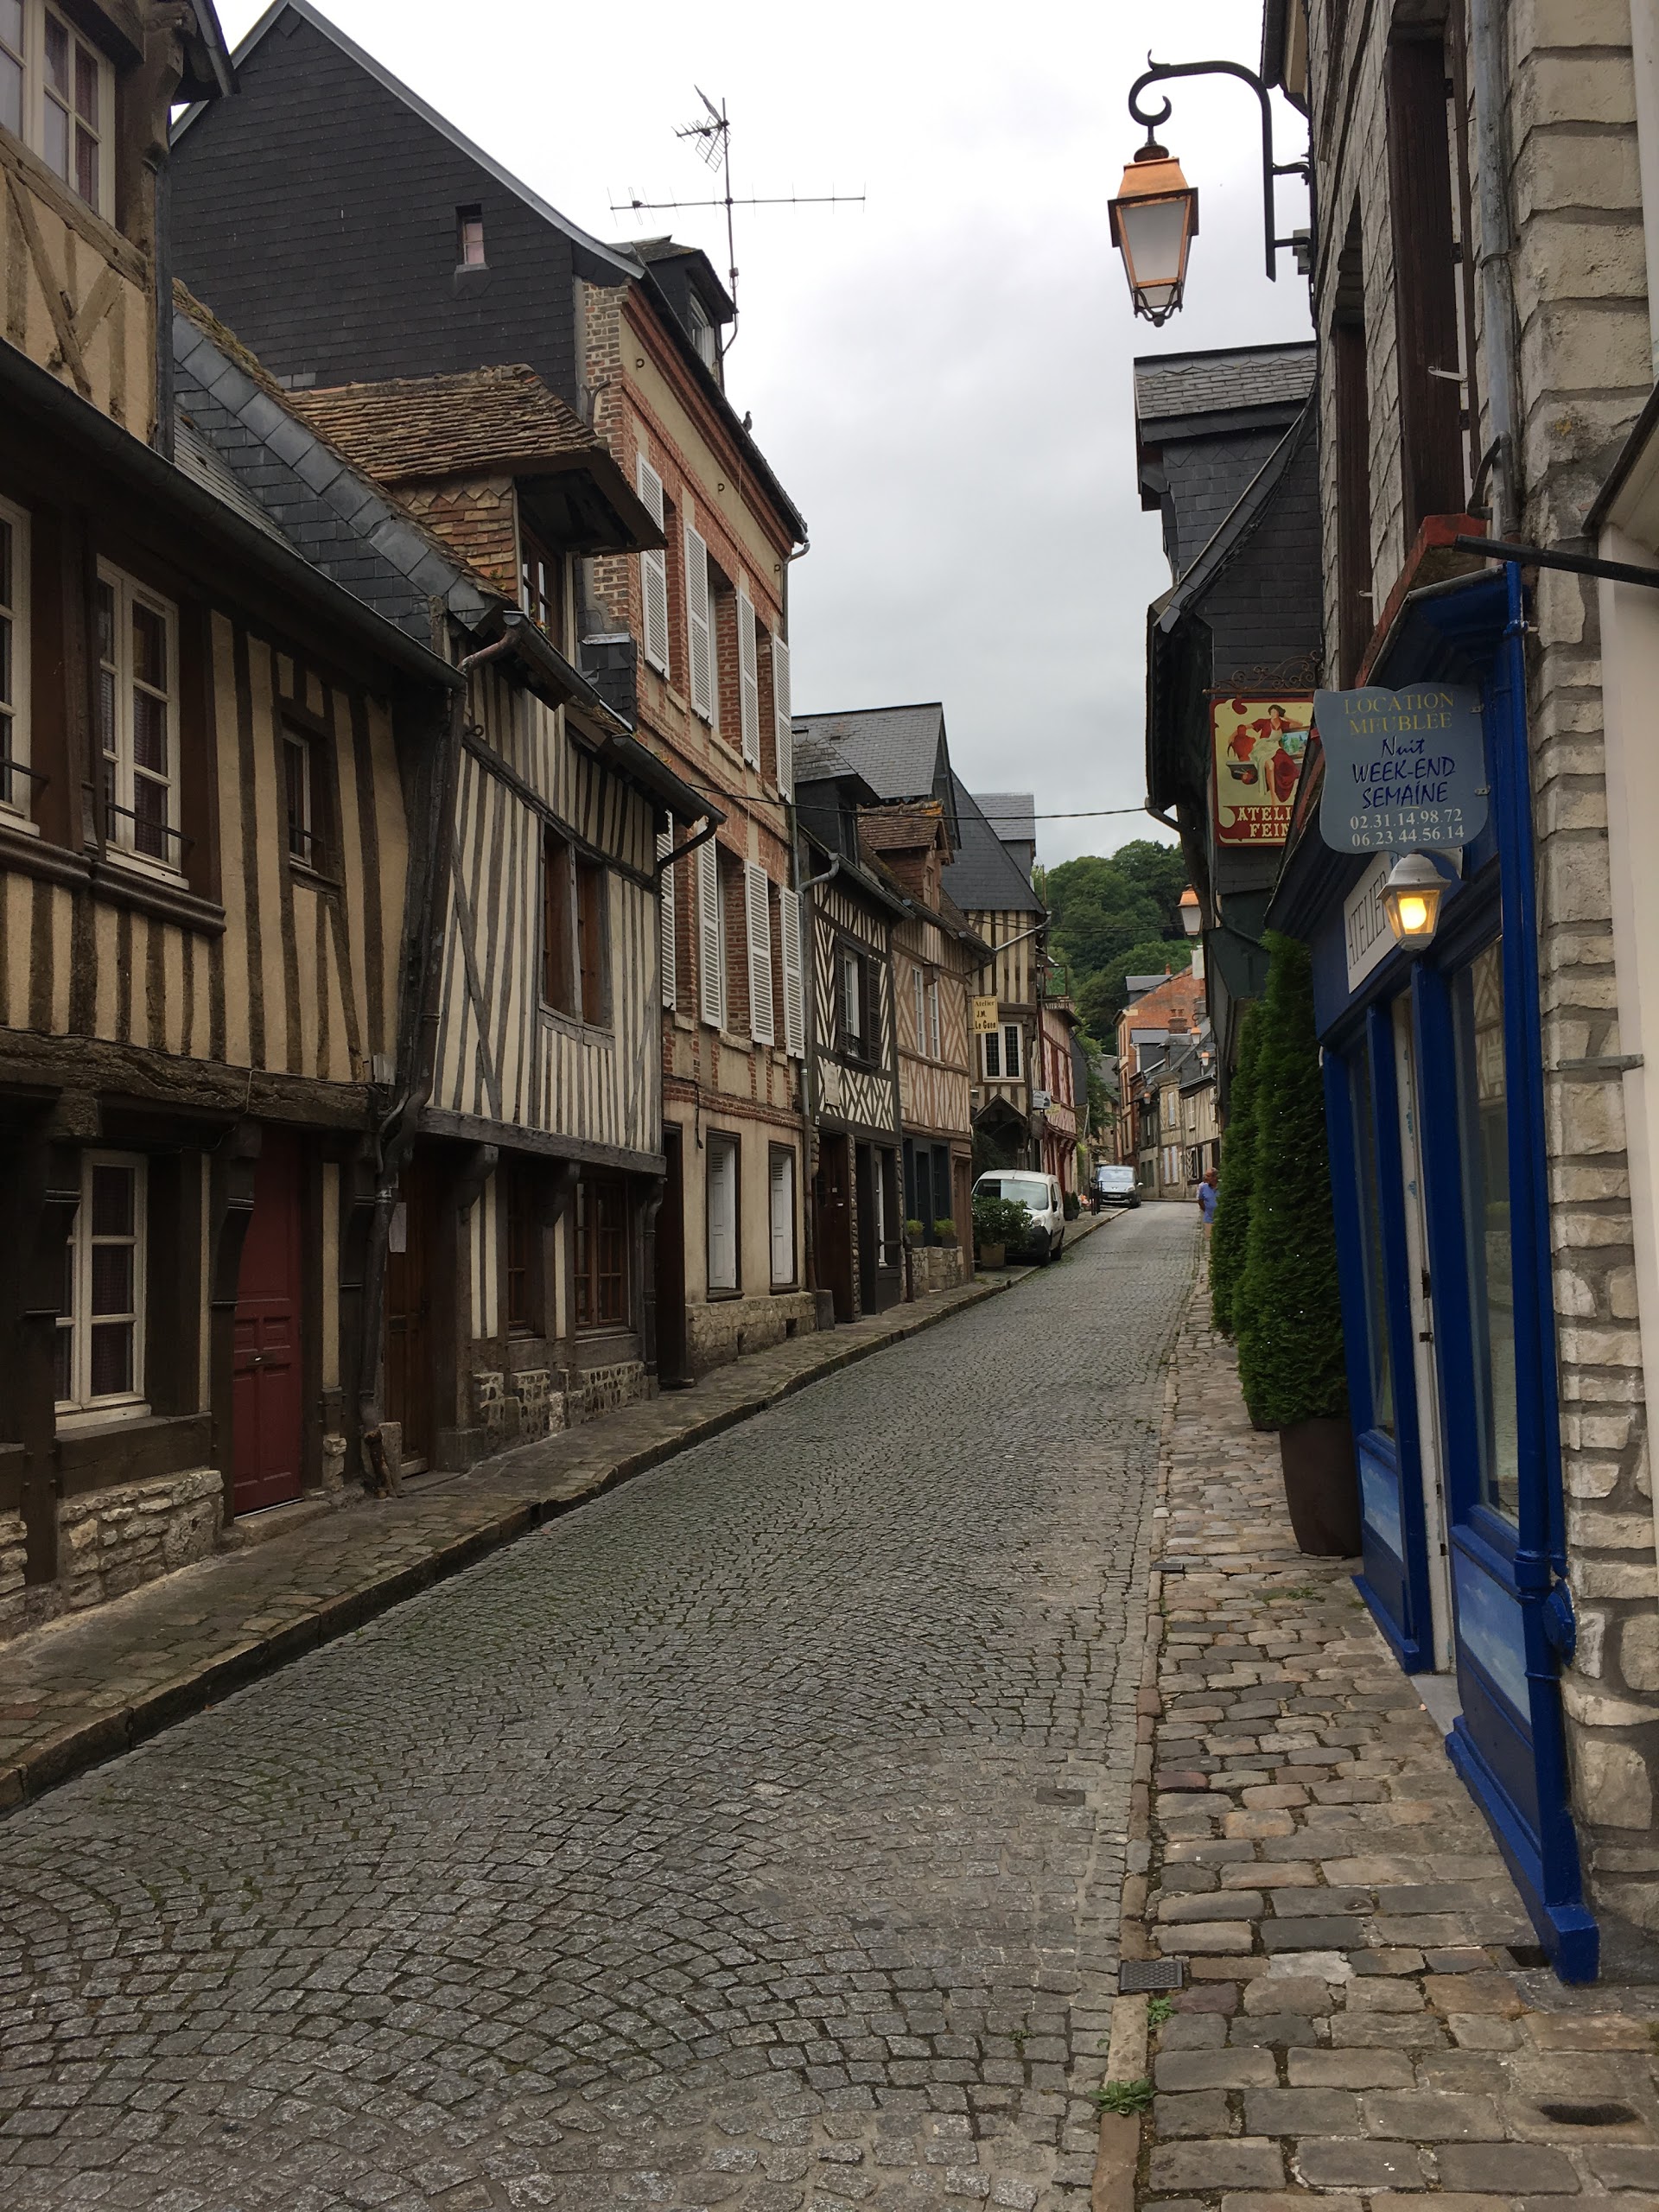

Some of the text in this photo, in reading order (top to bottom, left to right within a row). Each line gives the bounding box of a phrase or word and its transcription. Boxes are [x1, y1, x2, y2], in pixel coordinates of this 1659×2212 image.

[1344, 692, 1454, 715] LOCATION
[1382, 735, 1425, 758] Nuit
[1352, 756, 1456, 784] WEEK-END
[1350, 808, 1463, 830] 02.31.14.98.72
[1351, 824, 1465, 847] 06.23.44.56.14
[975, 1020, 982, 1029] Le
